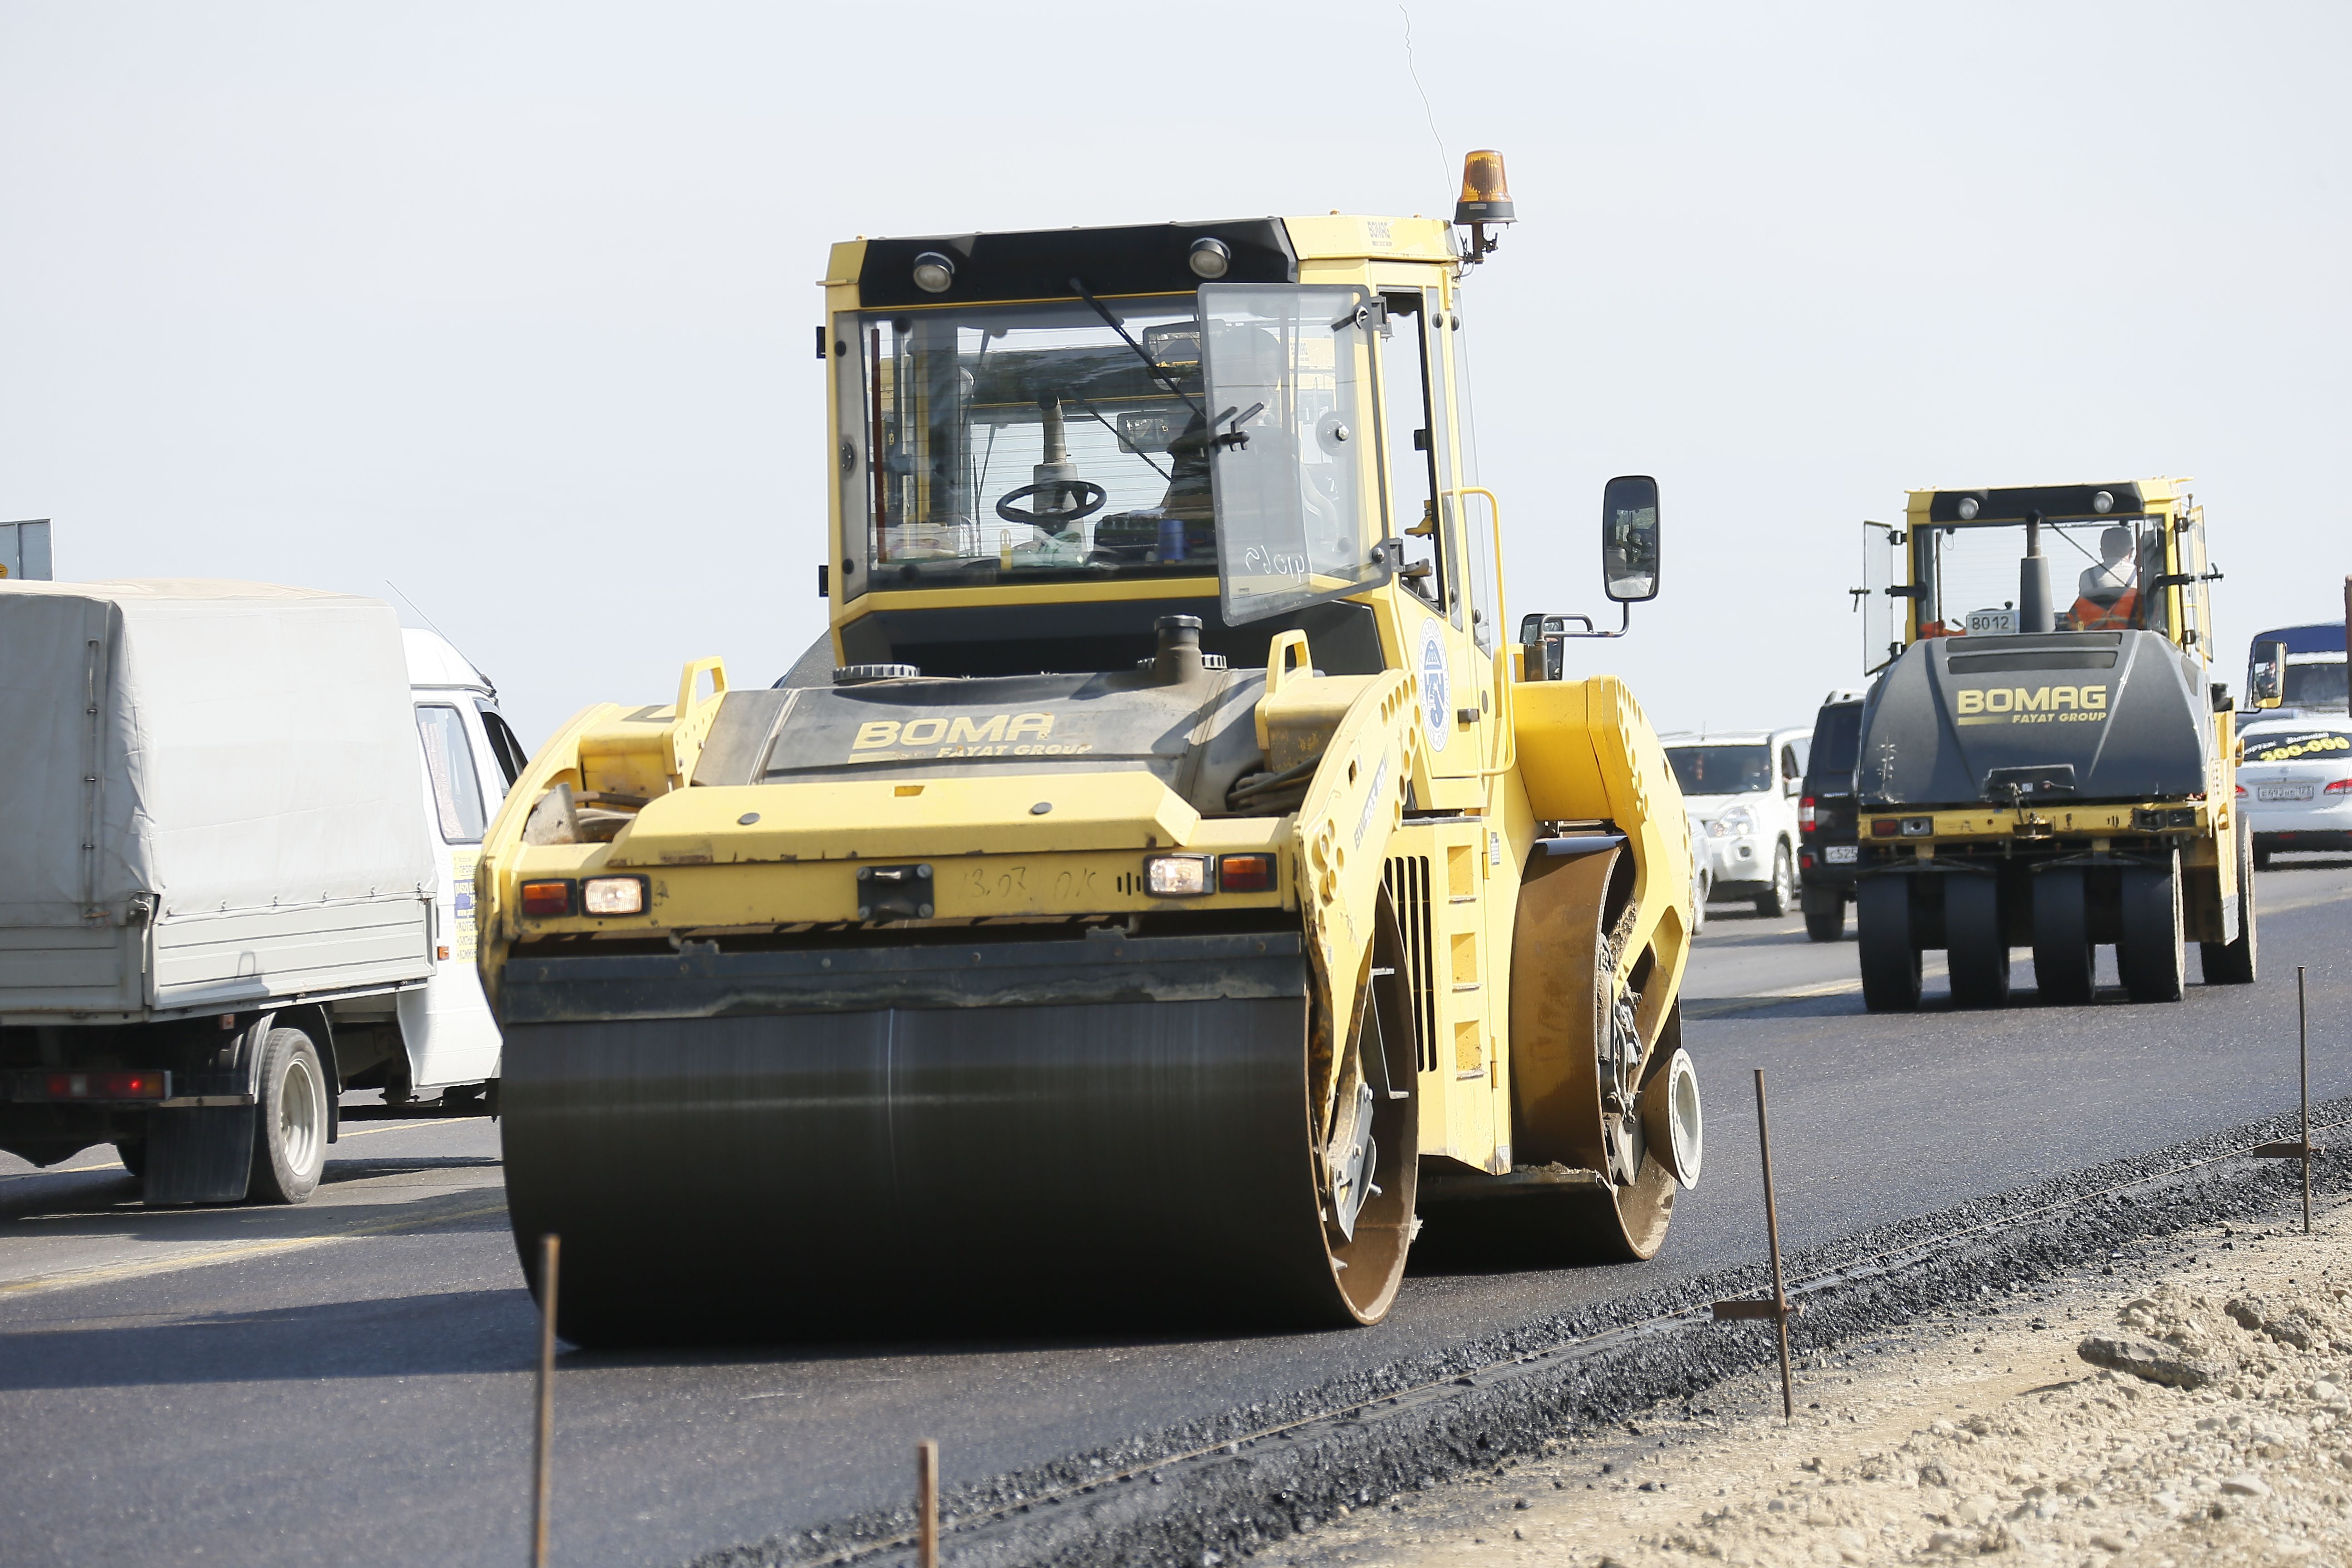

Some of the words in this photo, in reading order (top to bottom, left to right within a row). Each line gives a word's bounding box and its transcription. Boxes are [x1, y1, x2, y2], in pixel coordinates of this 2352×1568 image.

[1972, 616, 2009, 630] 8012
[1958, 685, 2107, 714] BOMAG
[2013, 713, 2055, 724] FAYAT
[2059, 712, 2107, 722] GROUP
[936, 744, 1009, 758] FAYAT
[1014, 744, 1093, 756] GROUP
